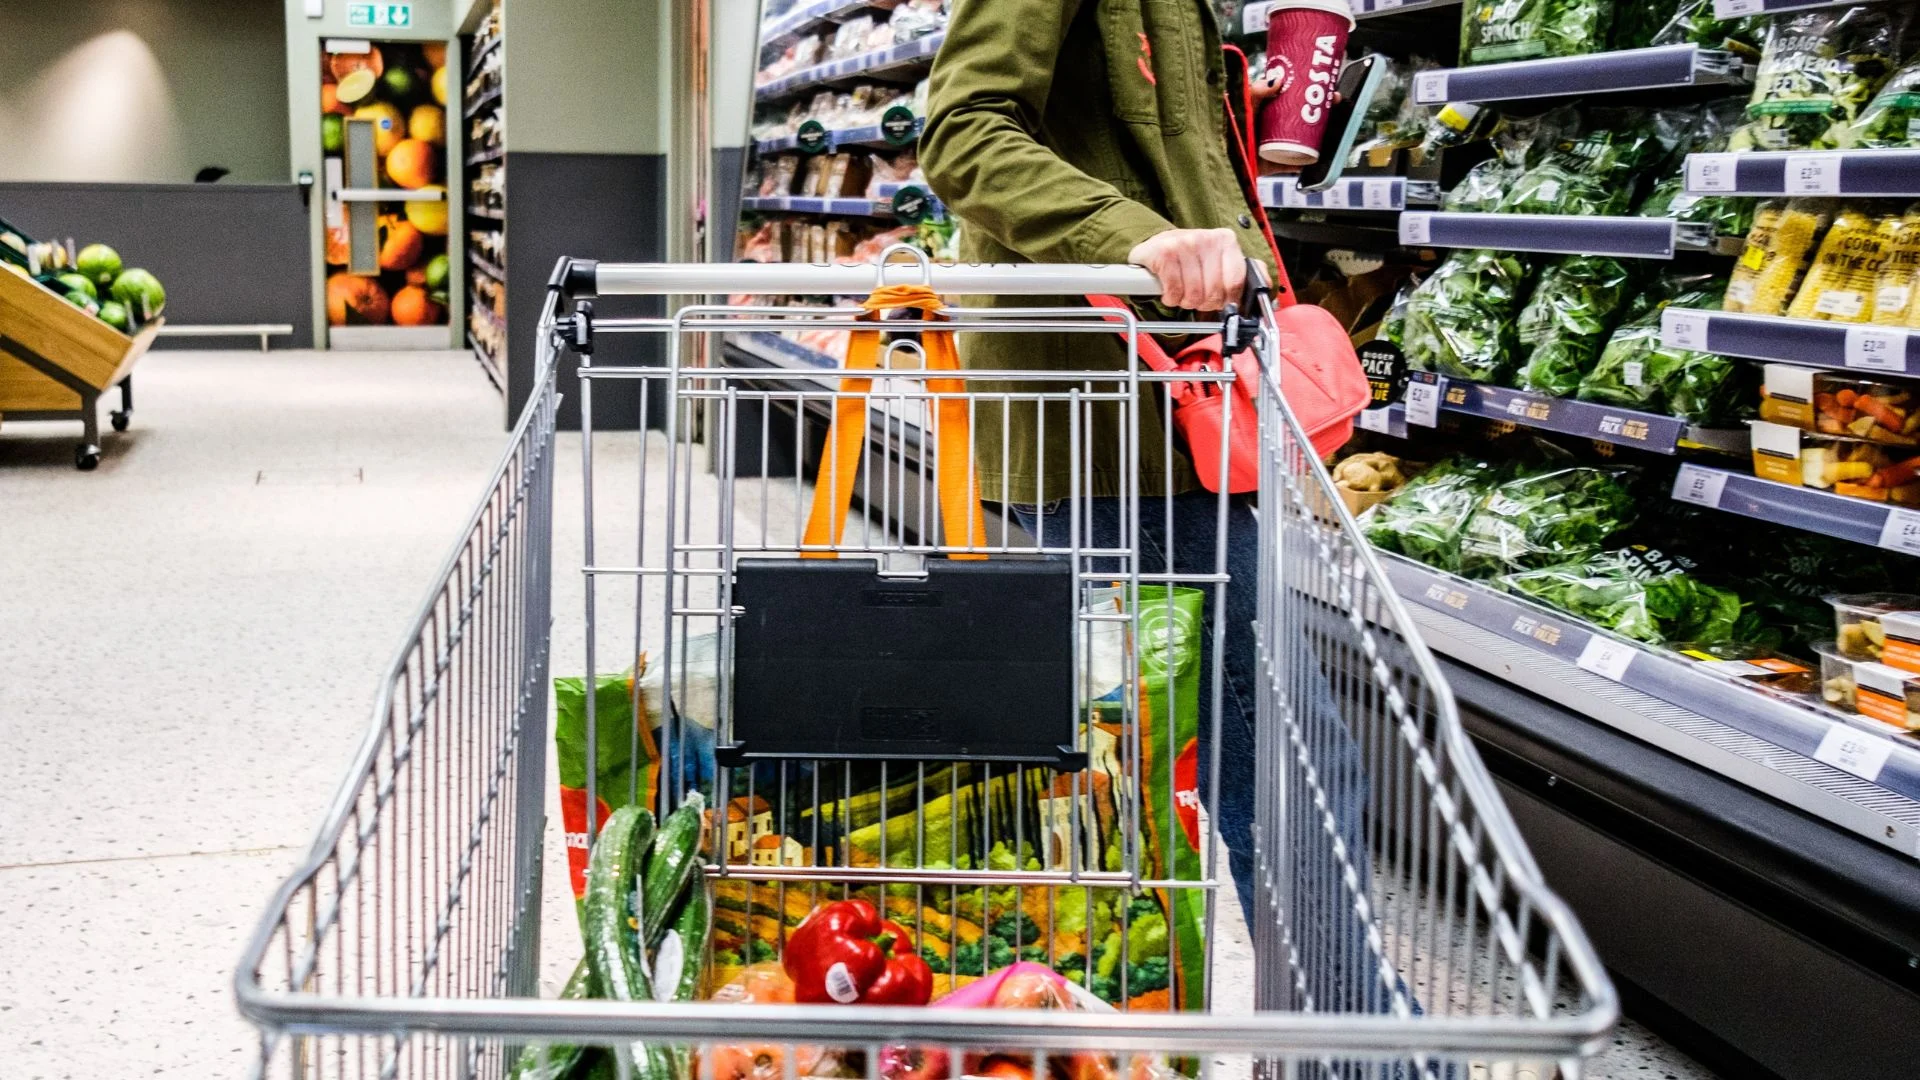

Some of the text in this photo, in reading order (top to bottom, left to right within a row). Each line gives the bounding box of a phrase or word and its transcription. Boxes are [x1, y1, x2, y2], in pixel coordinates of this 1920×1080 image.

[1301, 35, 1337, 124] COSTA
[1844, 236, 1881, 253] CORN
[1362, 351, 1396, 361] BIGGER
[1361, 359, 1394, 376] PACK
